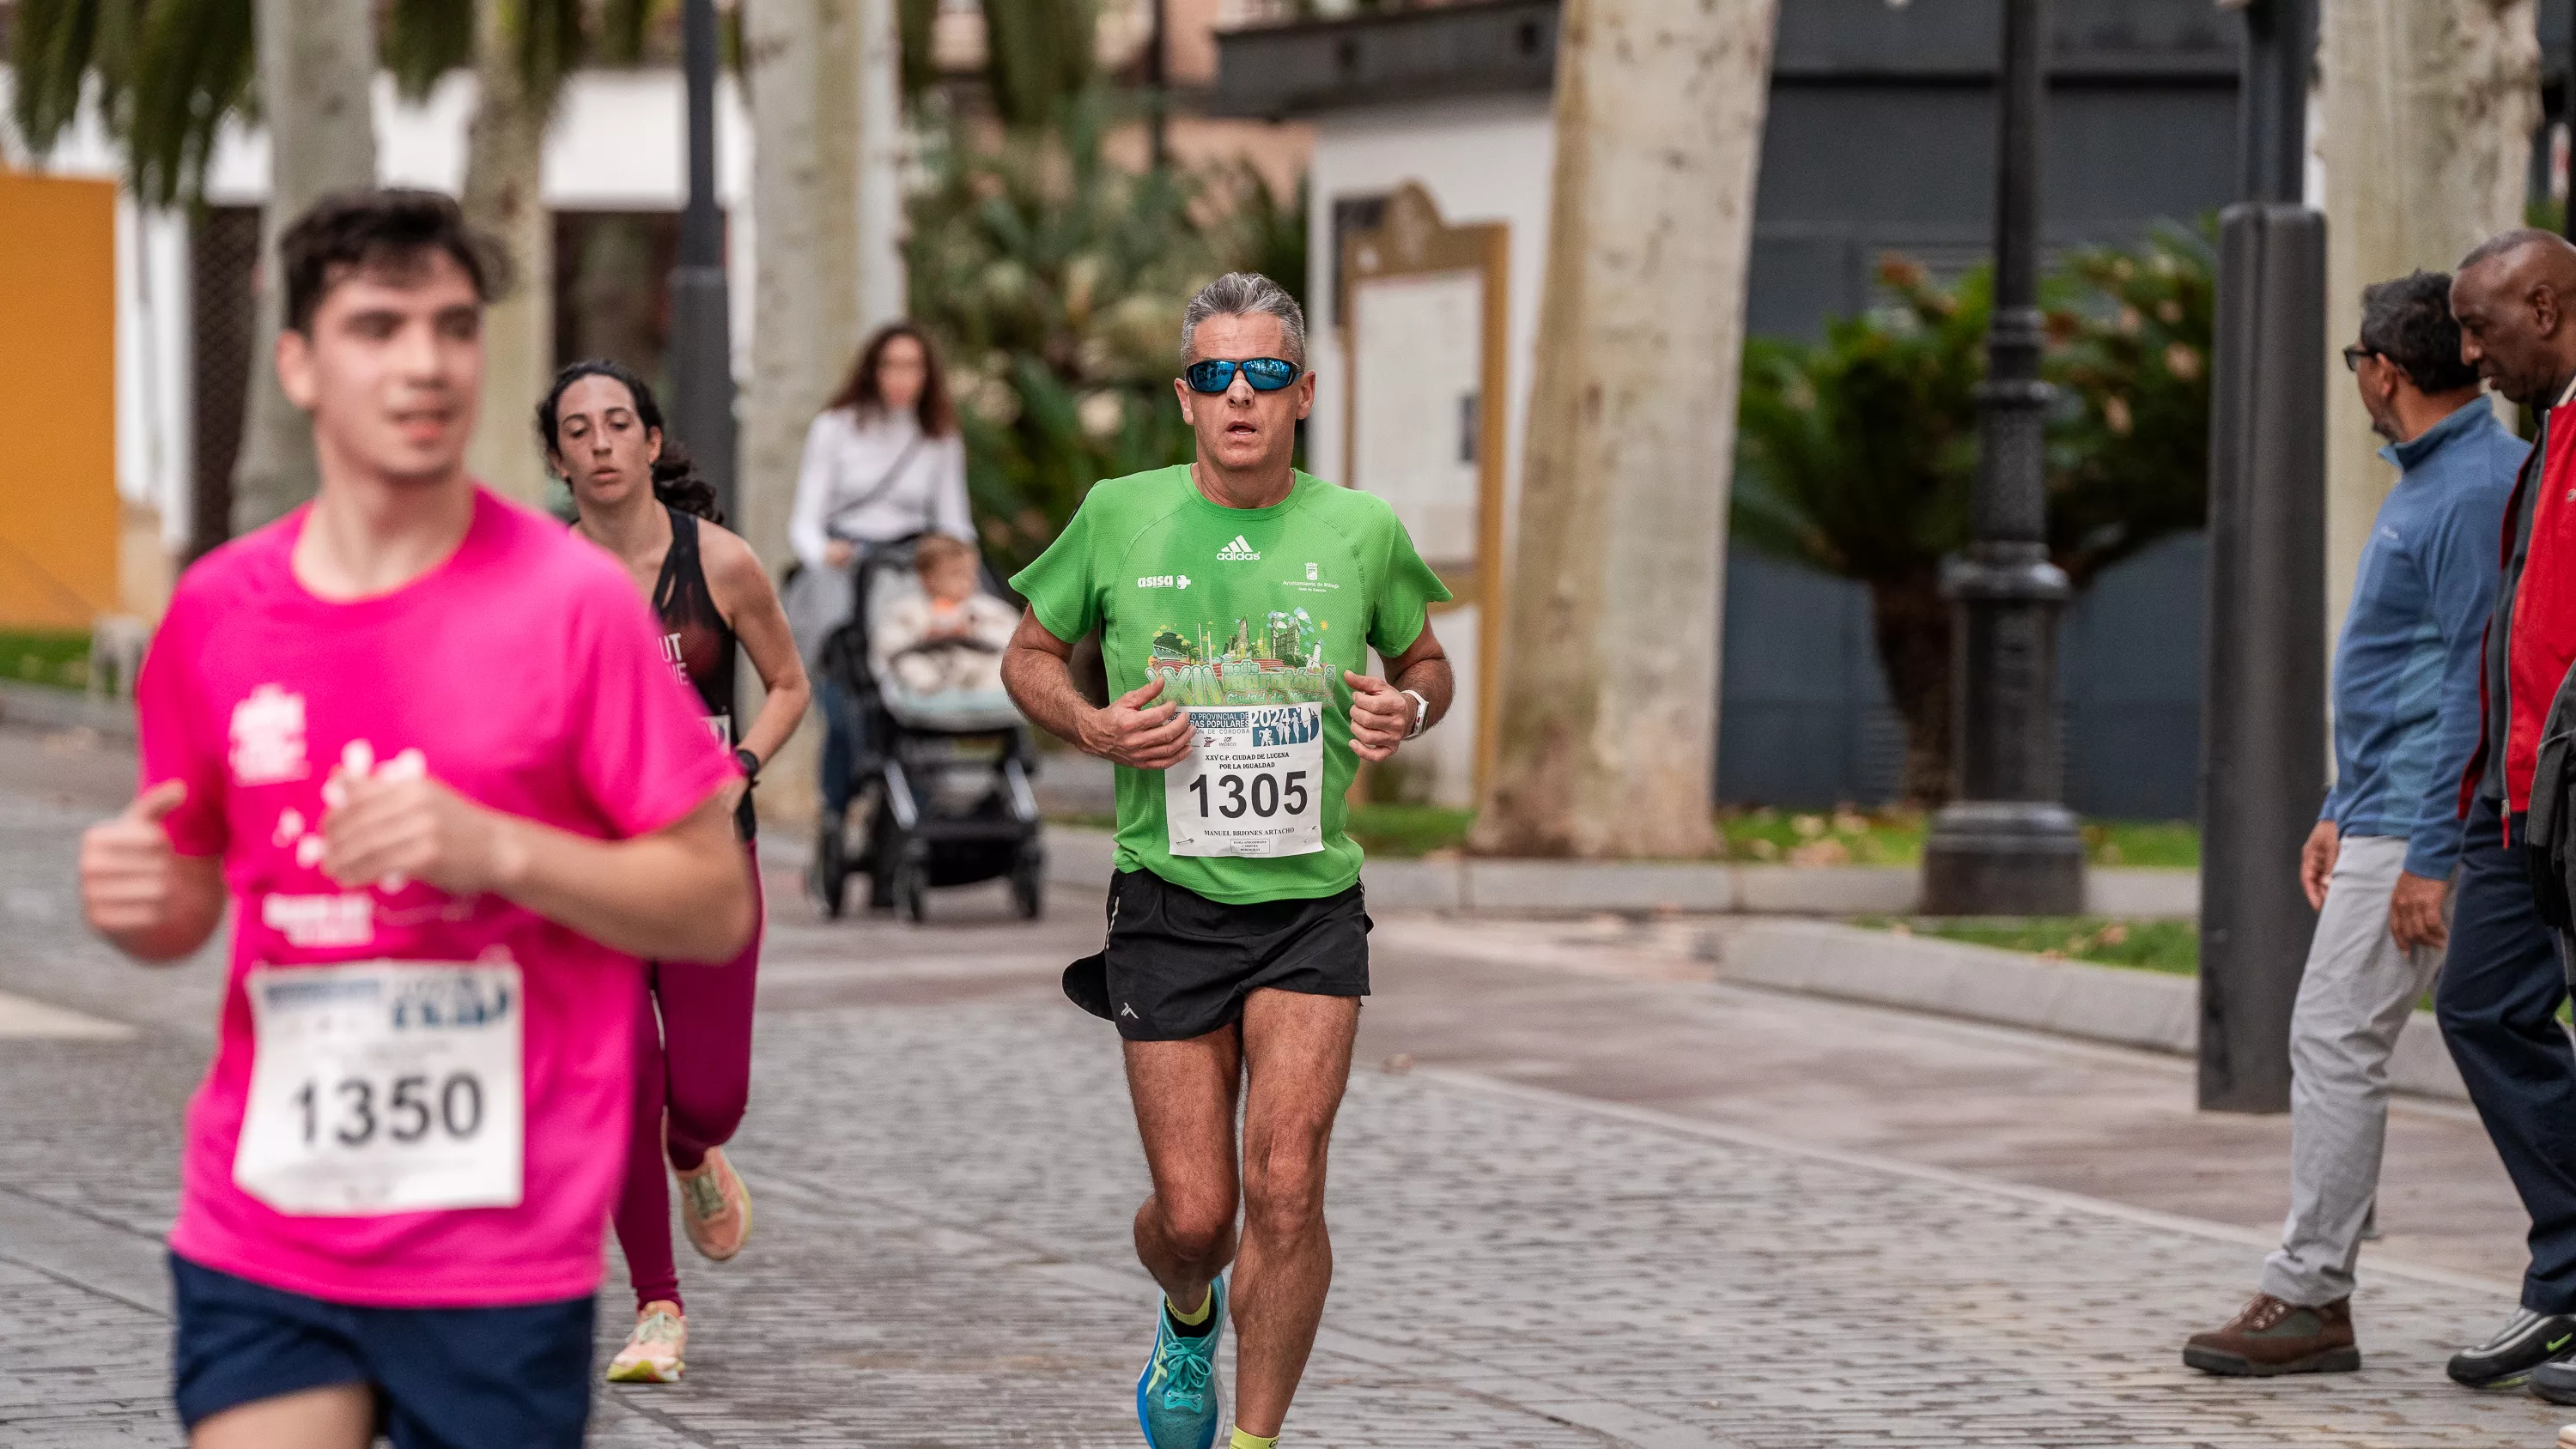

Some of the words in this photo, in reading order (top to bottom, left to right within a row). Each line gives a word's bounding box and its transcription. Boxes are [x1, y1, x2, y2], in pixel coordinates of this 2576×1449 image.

[1216, 551, 1261, 561] adidas
[1137, 575, 1173, 588] asisa
[1250, 709, 1291, 727] 2024
[1189, 770, 1308, 818] 1305
[1264, 827, 1295, 835] ARTACHO
[293, 1072, 486, 1147] 1350
